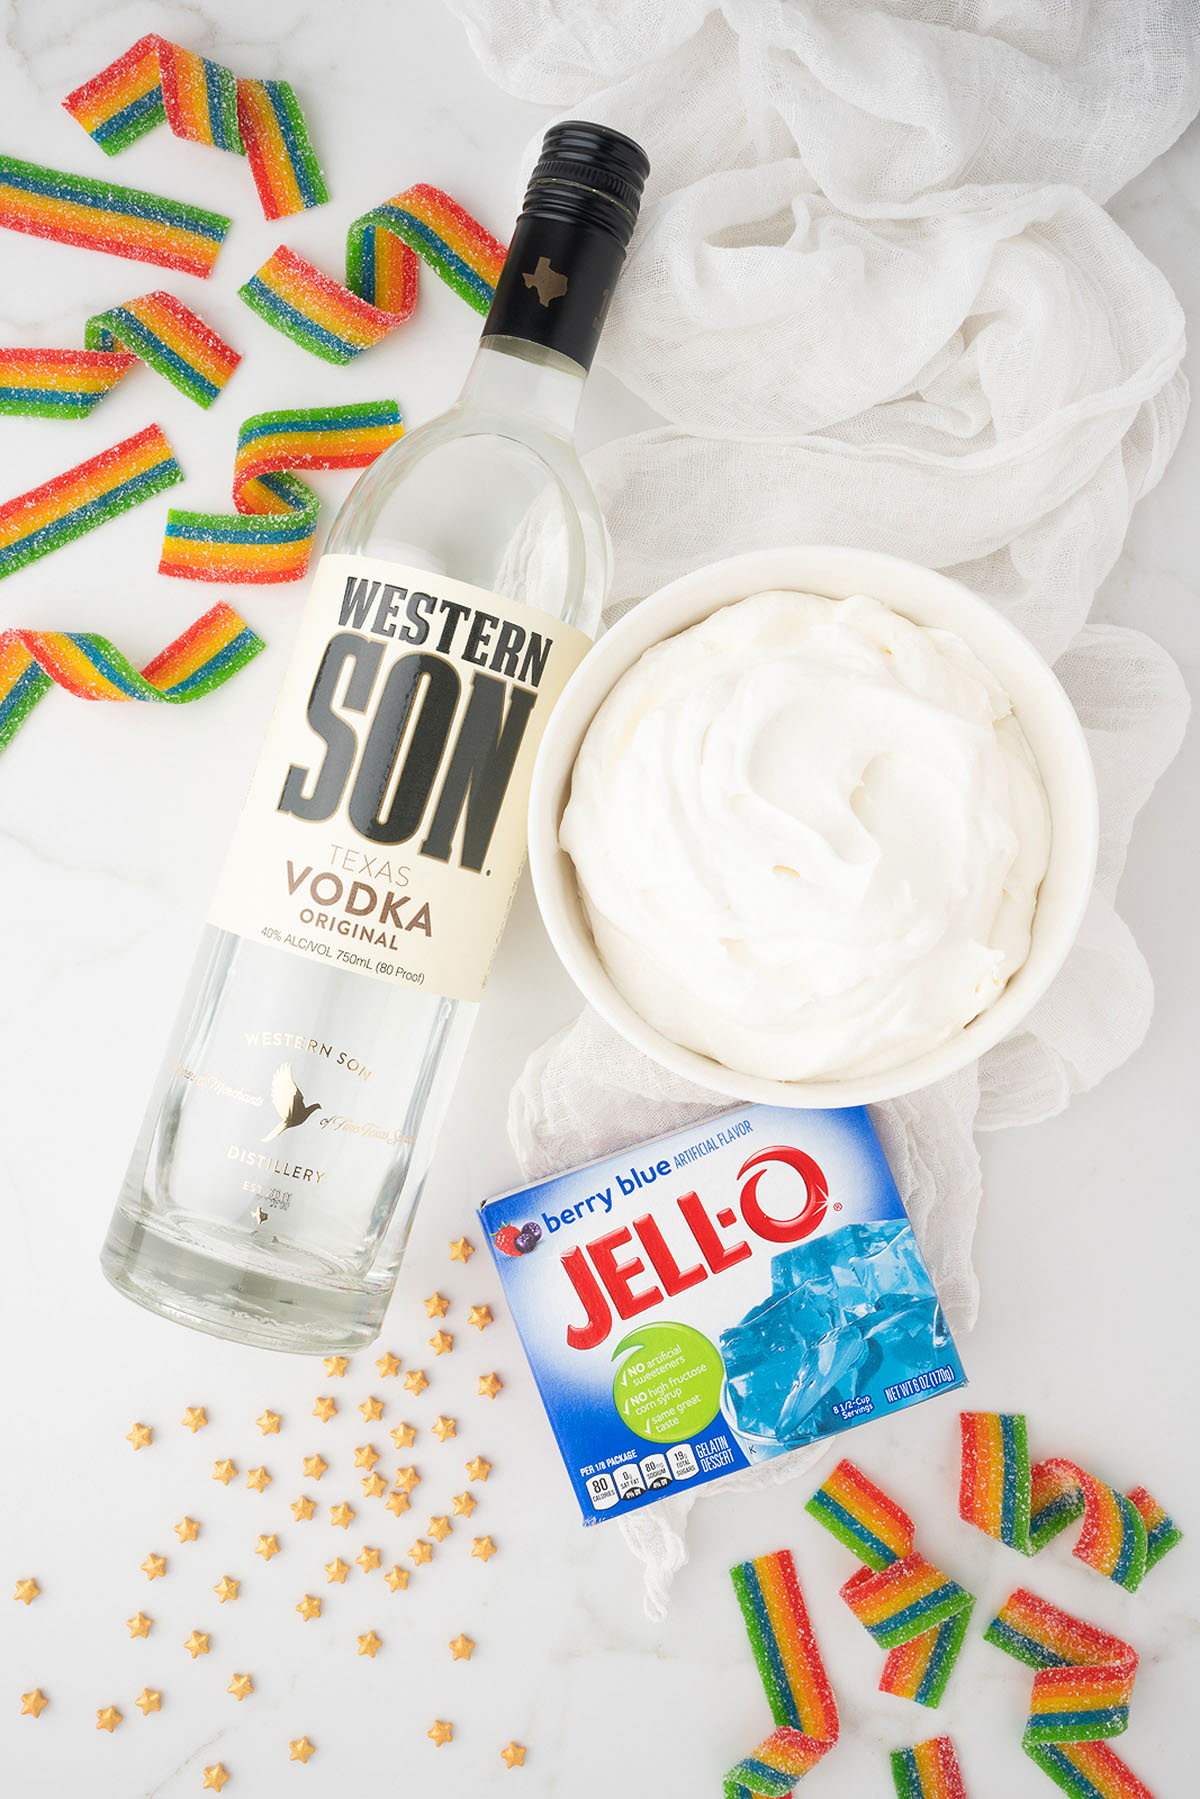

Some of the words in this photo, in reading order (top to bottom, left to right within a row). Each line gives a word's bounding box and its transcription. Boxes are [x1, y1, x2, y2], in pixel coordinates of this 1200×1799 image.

[338, 576, 553, 687] WESTERN
[331, 844, 411, 887] TEXAS
[287, 860, 432, 937] VODKA
[300, 908, 398, 950] ORIGINAL
[261, 926, 282, 942] 40%
[284, 933, 332, 958] ALC/VOL
[336, 949, 373, 970] 750mL
[375, 961, 394, 976] (80
[395, 966, 425, 986] Proof)
[245, 1032, 333, 1058] WESTERN
[336, 1052, 373, 1081] SON
[227, 1144, 326, 1184] DISTILLERY
[541, 1187, 613, 1234] berry
[615, 1159, 672, 1196] blue
[673, 1138, 719, 1169] ARTIFICIAL
[718, 1119, 754, 1147] FLAVOR
[560, 1145, 829, 1350] JELL-O
[627, 1363, 645, 1378] NO
[647, 1344, 682, 1369] artificial
[633, 1355, 686, 1386] sweeteners
[630, 1392, 648, 1406] NO
[648, 1382, 669, 1398] high
[669, 1364, 708, 1388] fructose
[885, 1385, 901, 1402] NET
[900, 1380, 914, 1397] WT
[913, 1379, 920, 1392] 6
[929, 1366, 955, 1387] (170g)
[635, 1401, 657, 1415] corn
[657, 1388, 682, 1405] syrup
[652, 1408, 676, 1424] same
[677, 1395, 702, 1414] great
[833, 1406, 839, 1414] 8
[840, 1396, 871, 1412] 1/2-Cup
[842, 1403, 874, 1419] Servings
[656, 1417, 680, 1433] taste
[695, 1435, 729, 1459] GELATIN
[701, 1448, 736, 1473] DESSERT
[748, 1445, 757, 1455] K
[580, 1466, 595, 1477] PER
[595, 1461, 606, 1471] 1/8
[606, 1449, 638, 1467] PACKAGE
[647, 1468, 666, 1480] SODIUM
[676, 1460, 691, 1469] TOTAL
[676, 1465, 696, 1476] SUGARS
[592, 1477, 609, 1494] 80
[592, 1489, 616, 1502] CALORIES
[620, 1481, 631, 1490] SAT
[631, 1478, 640, 1487] FAT
